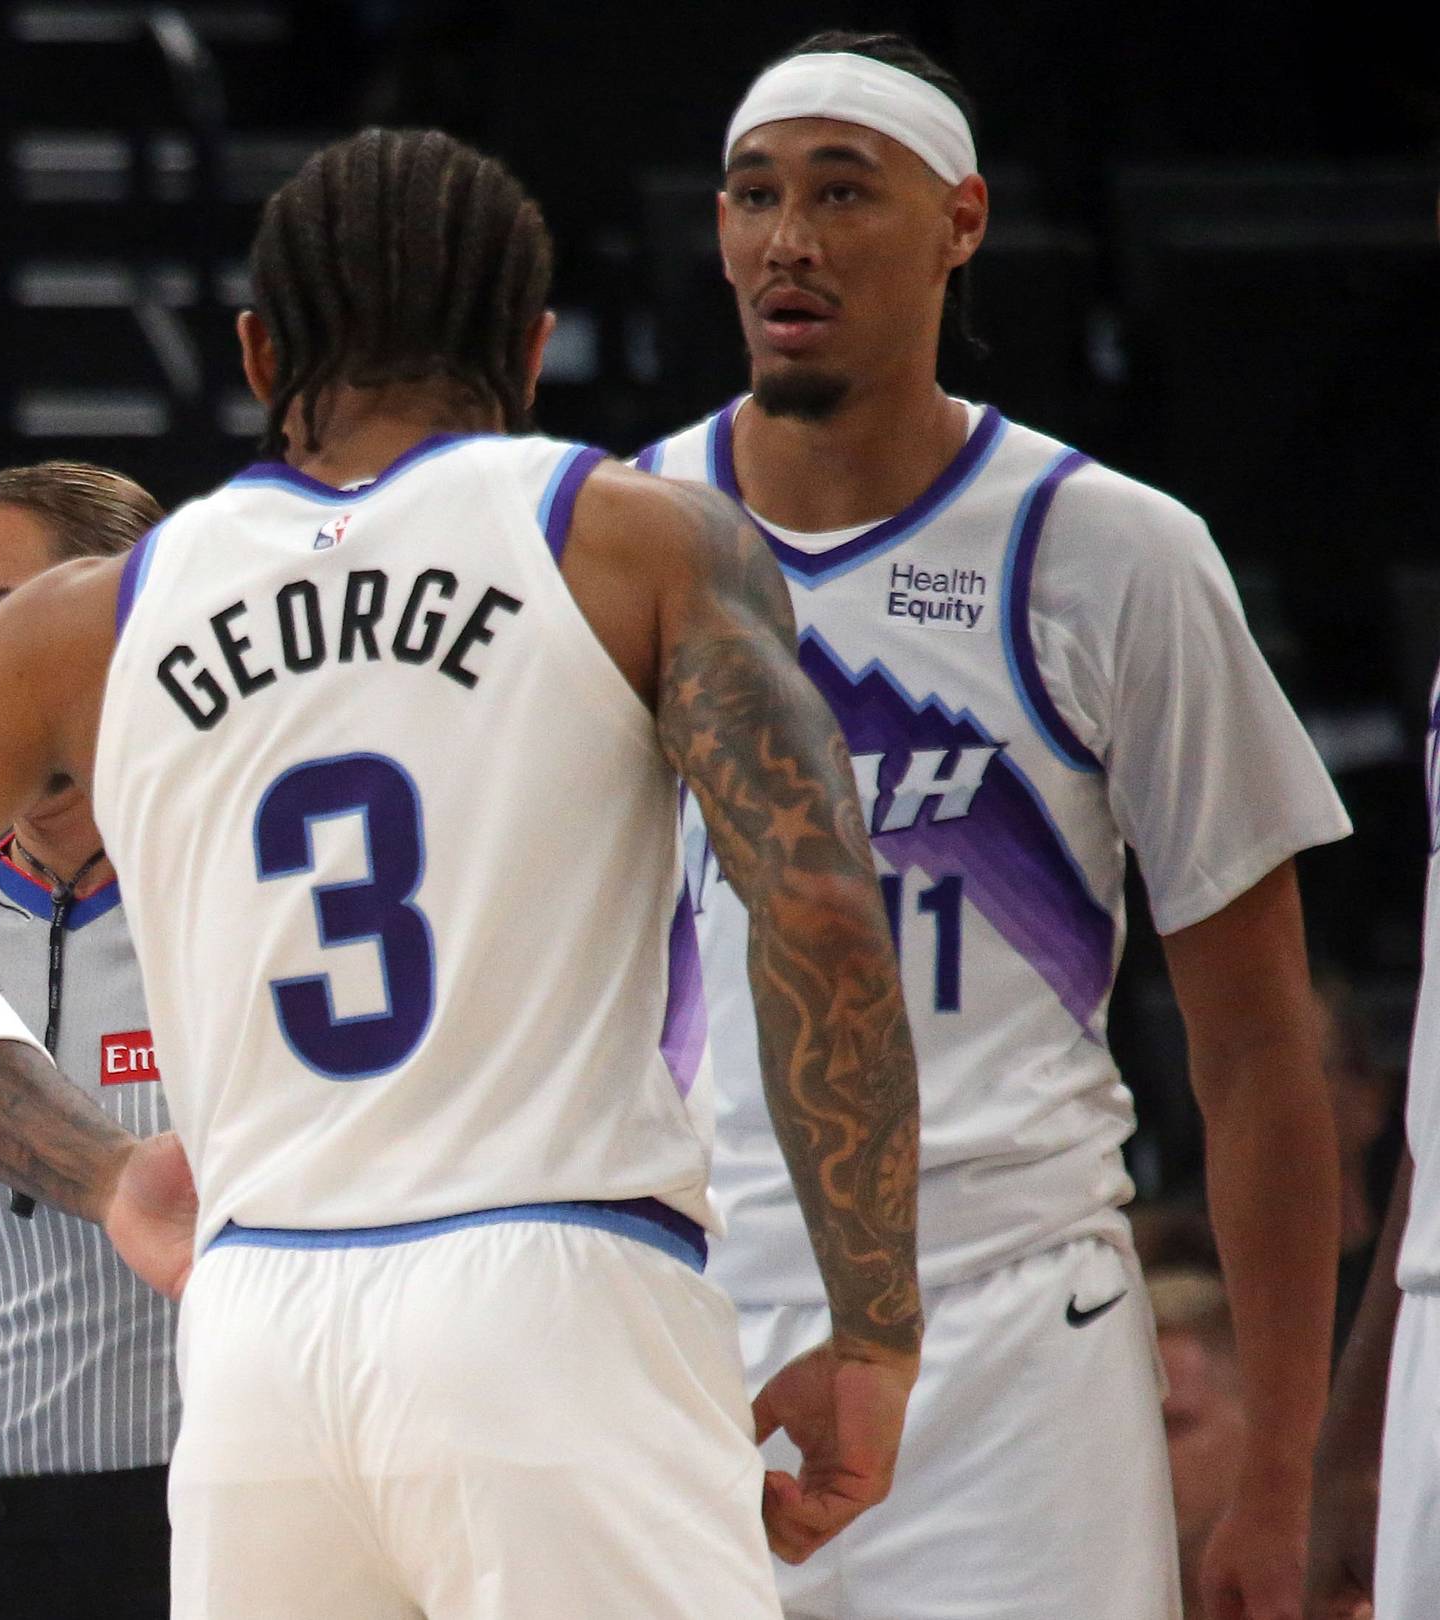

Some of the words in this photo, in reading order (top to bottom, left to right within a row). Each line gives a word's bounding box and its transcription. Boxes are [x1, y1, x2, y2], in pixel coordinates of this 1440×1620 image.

[888, 592, 984, 629] Equity
[891, 563, 986, 595] Health
[157, 568, 523, 731] GEORGE
[253, 752, 436, 1082] 3
